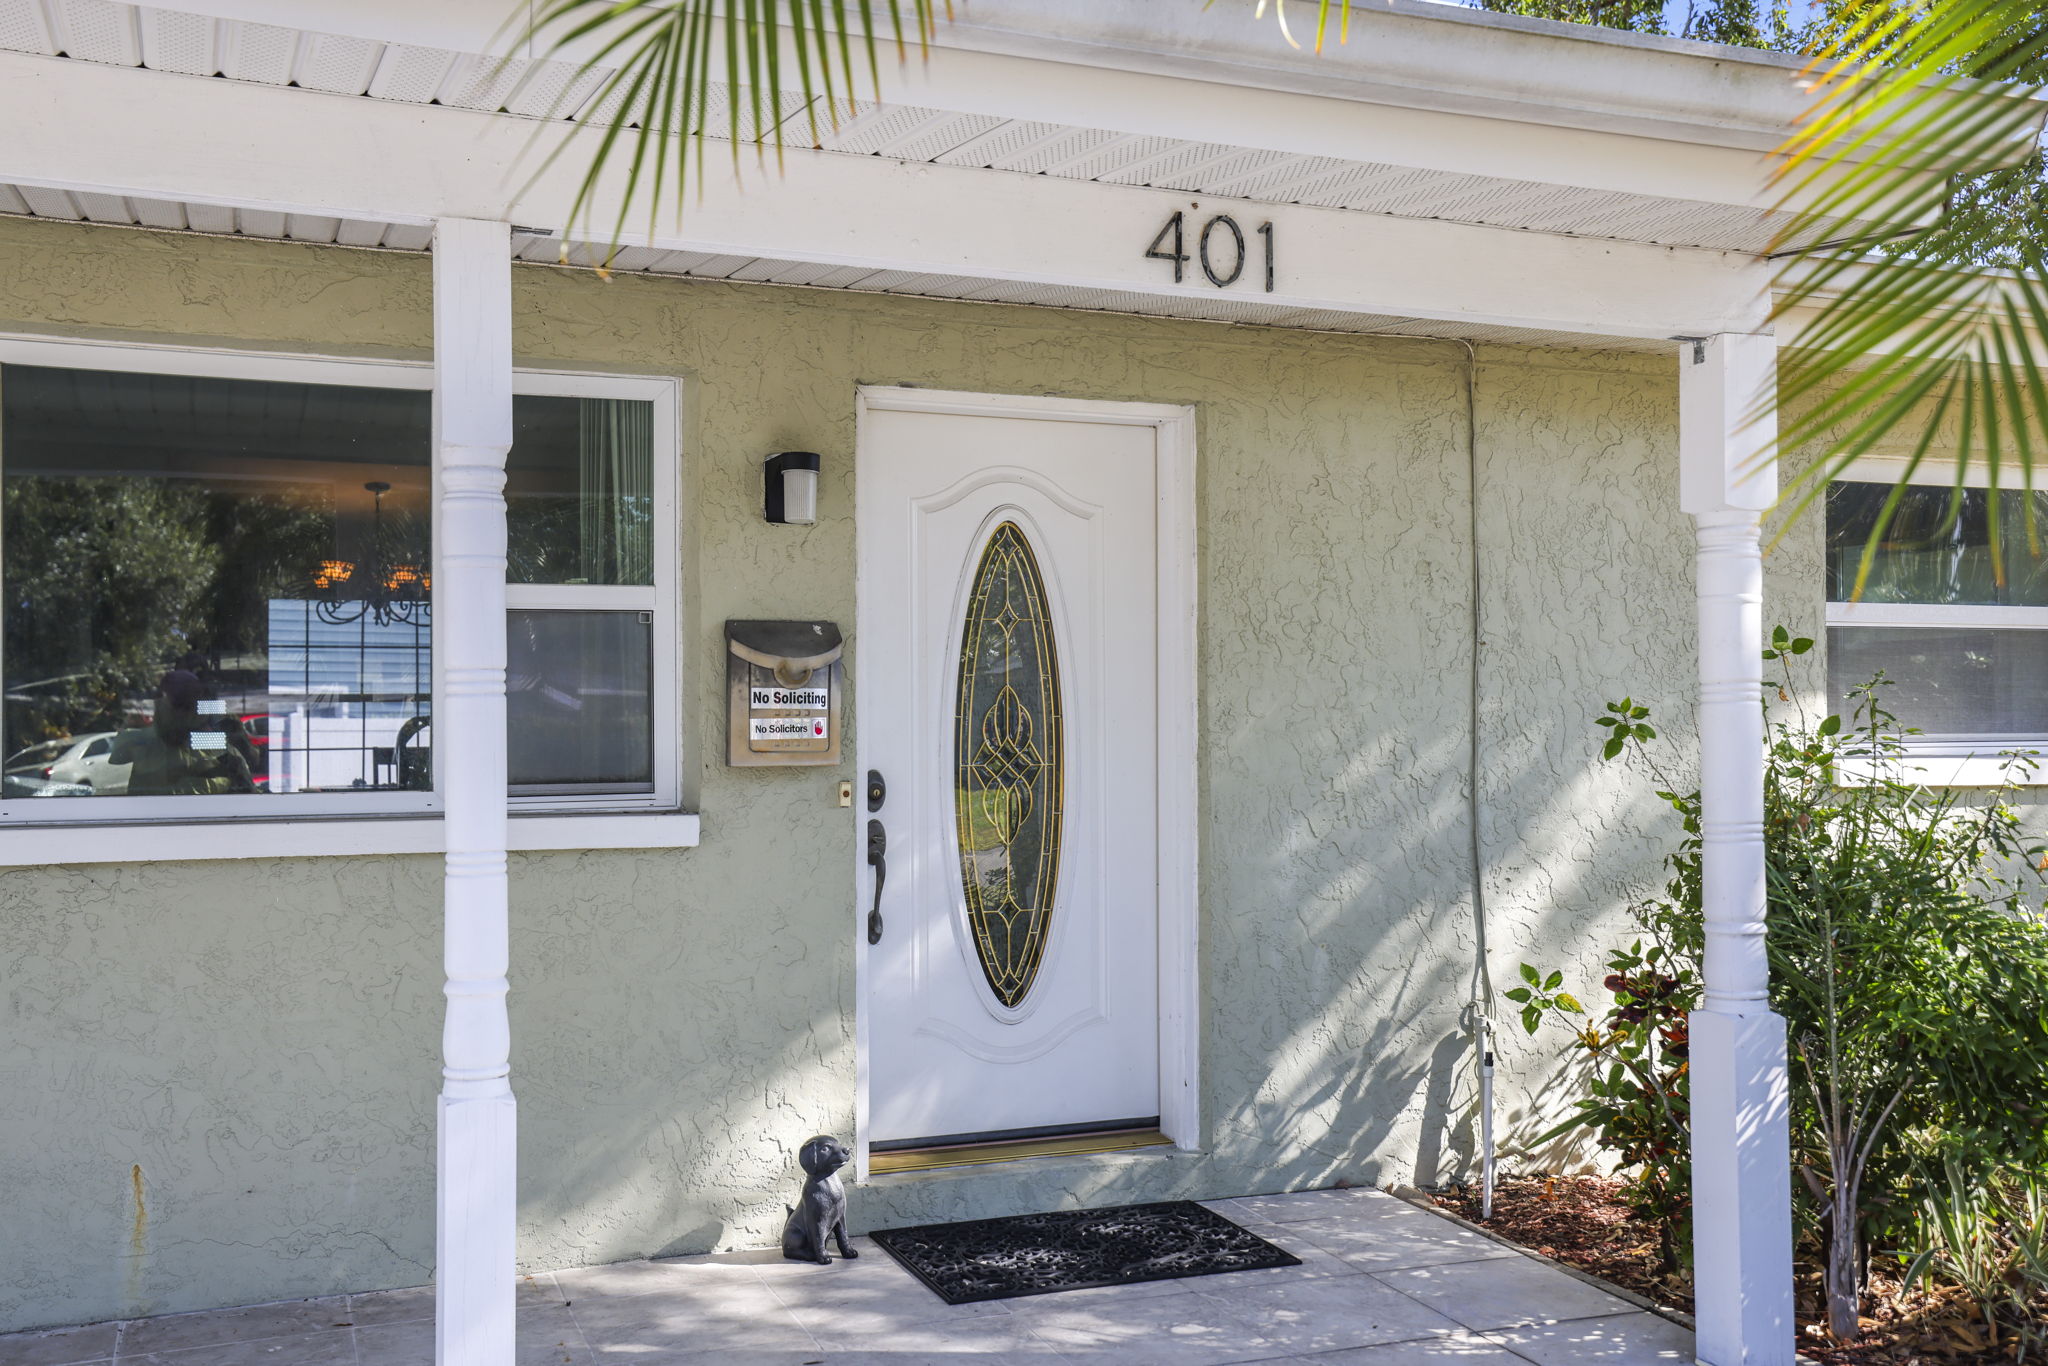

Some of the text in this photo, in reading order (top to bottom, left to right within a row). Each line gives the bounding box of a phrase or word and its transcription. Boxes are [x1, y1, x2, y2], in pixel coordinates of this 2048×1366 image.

[1145, 211, 1274, 293] 401
[753, 691, 826, 707] No Soliciting
[755, 724, 808, 734] No Solicitors
